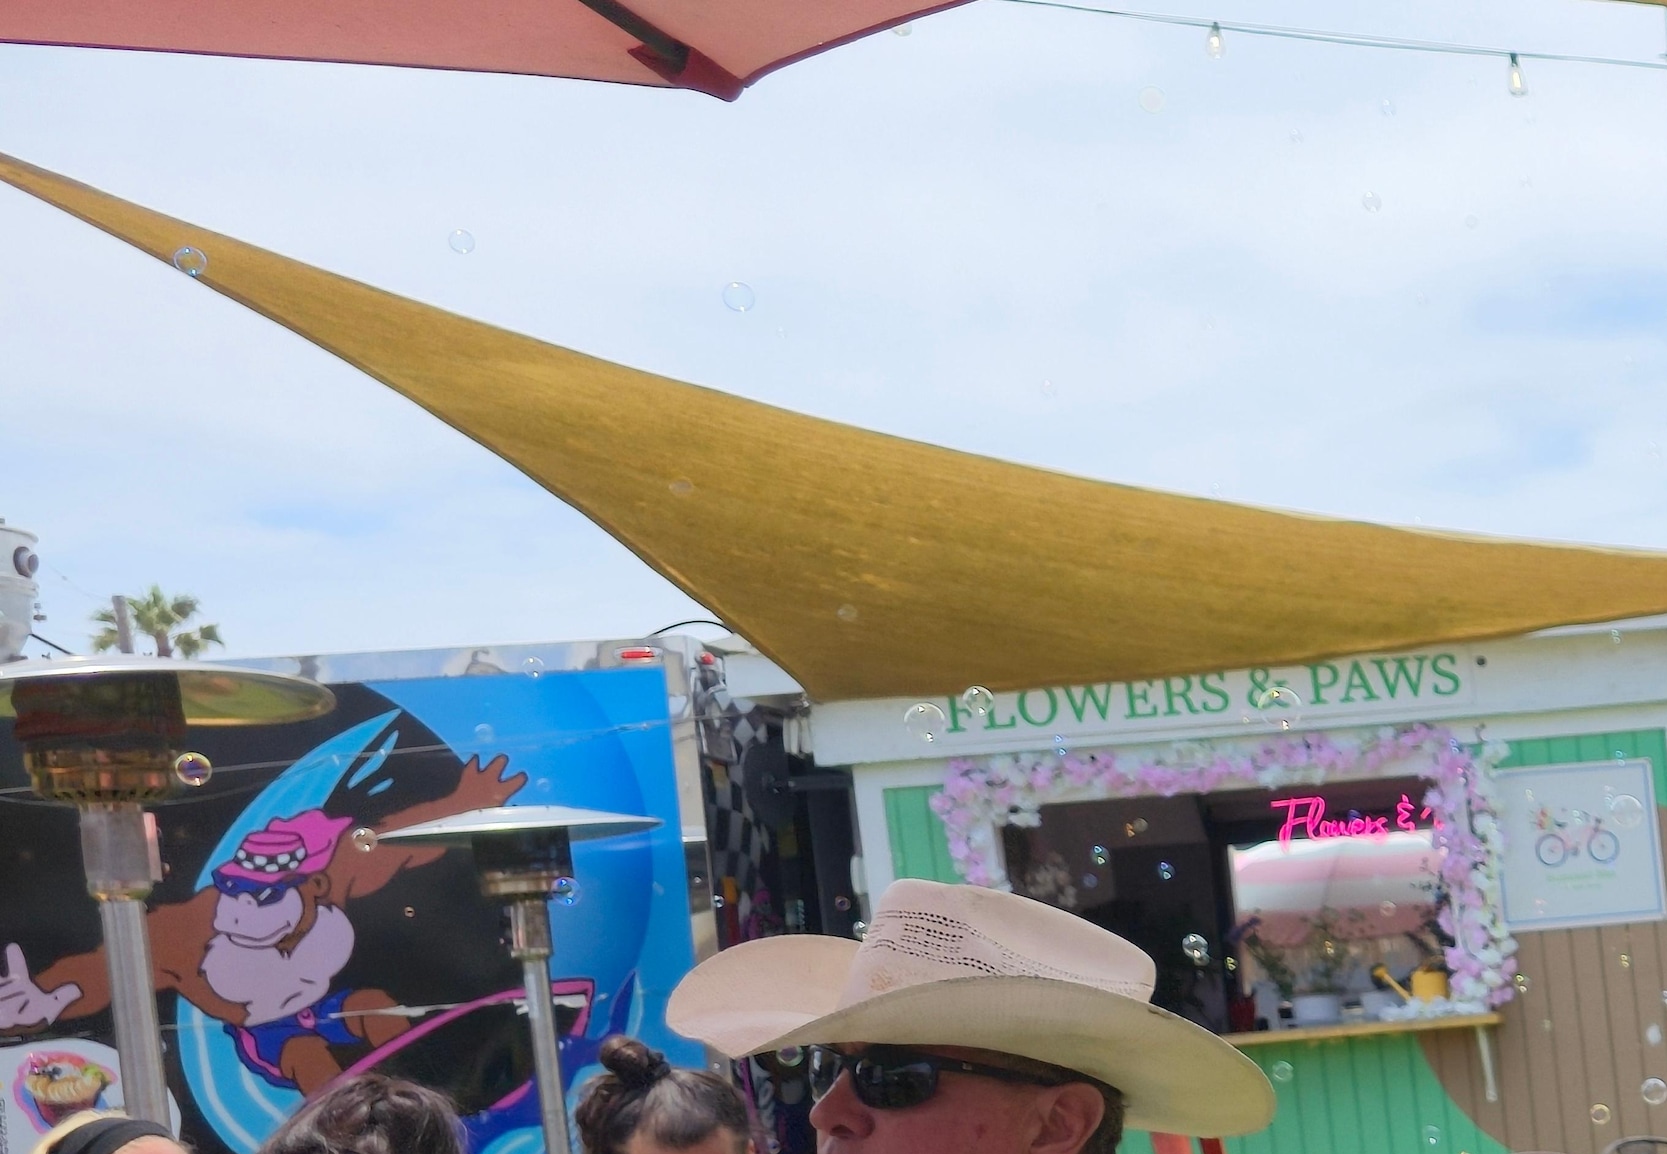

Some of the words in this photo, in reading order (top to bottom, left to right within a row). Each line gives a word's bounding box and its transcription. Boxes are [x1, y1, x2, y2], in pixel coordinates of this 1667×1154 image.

[946, 671, 1231, 733] FLOWERS
[1246, 665, 1291, 710] &
[1302, 653, 1460, 705] PAWS
[1270, 796, 1390, 852] Flowers
